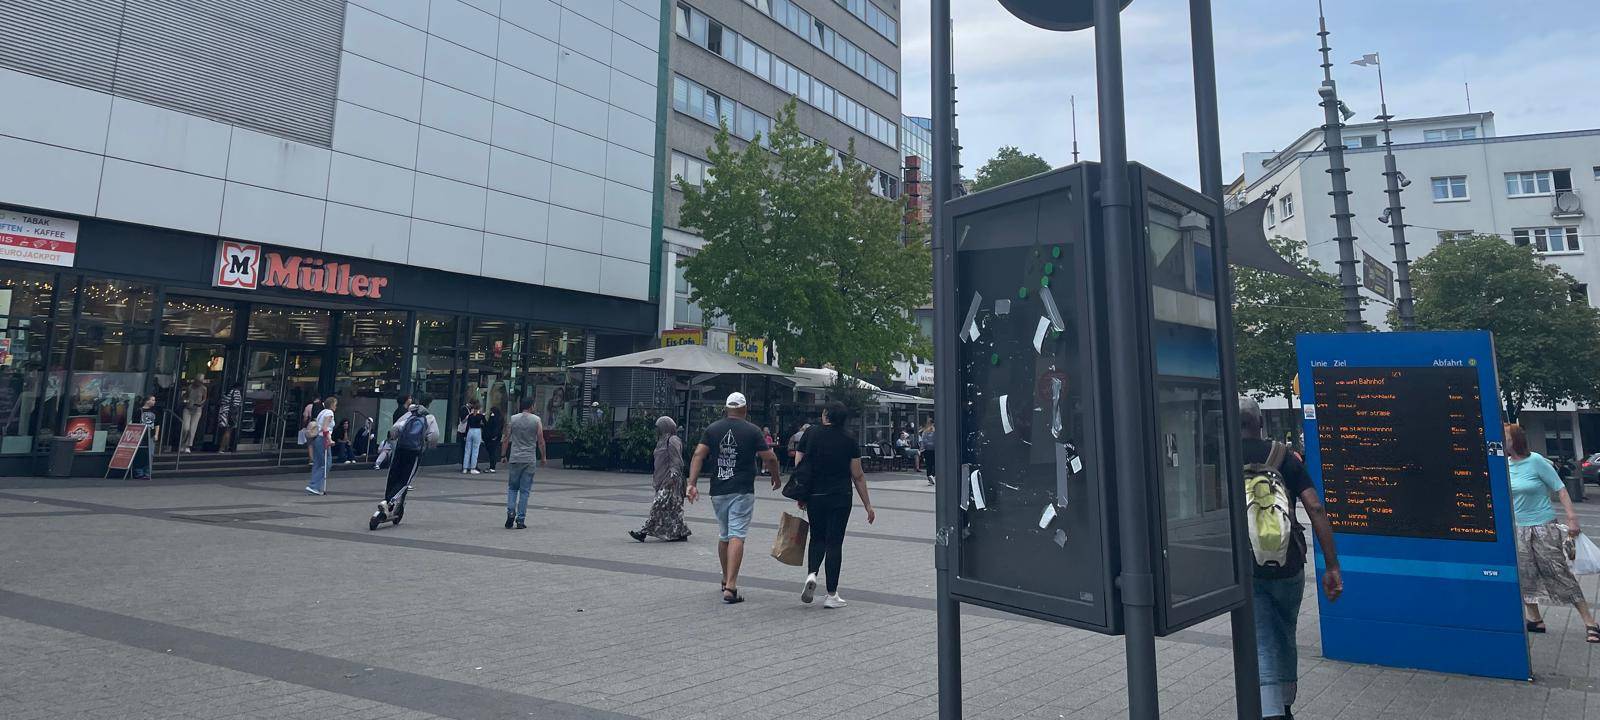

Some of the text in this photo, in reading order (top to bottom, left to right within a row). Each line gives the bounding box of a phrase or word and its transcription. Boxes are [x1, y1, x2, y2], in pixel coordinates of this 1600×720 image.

[22, 216, 51, 227] TABAK
[34, 228, 66, 239] KAFFEE
[0, 248, 62, 262] EUROJACKPOT
[229, 254, 251, 275] M
[261, 253, 388, 299] Müller
[1310, 359, 1347, 368] Linie Ziel
[1432, 359, 1464, 367] Abfahrt
[1358, 378, 1385, 386] Bahnhof
